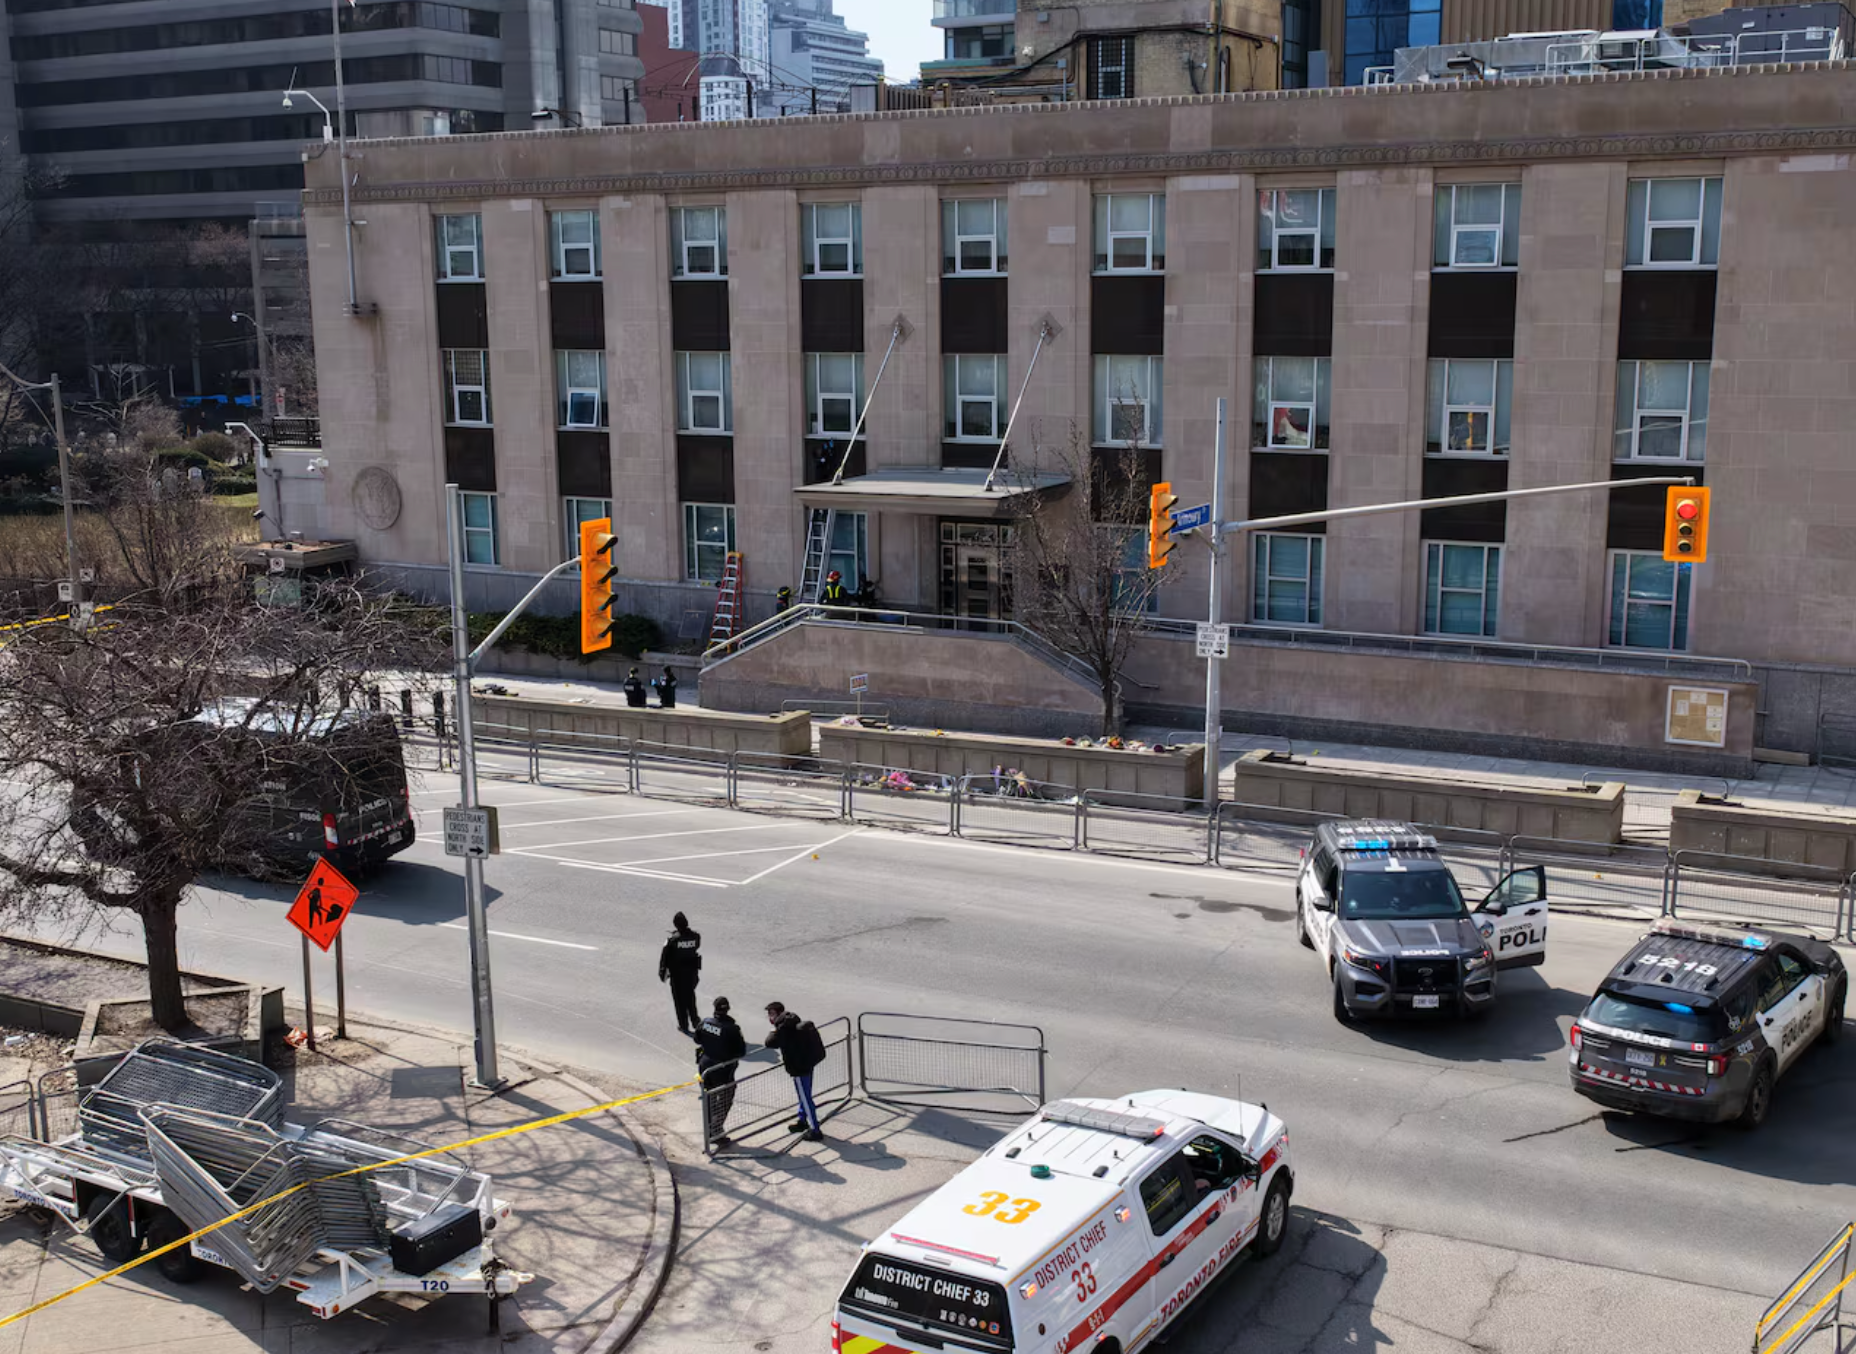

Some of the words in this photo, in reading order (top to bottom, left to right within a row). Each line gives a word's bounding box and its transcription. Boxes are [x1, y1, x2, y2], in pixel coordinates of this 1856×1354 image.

[446, 811, 485, 824] PEDESTRIANS
[450, 822, 469, 833] CROSS
[474, 825, 482, 833] AT
[448, 833, 466, 843] NORTH
[472, 835, 484, 845] SIDE
[448, 843, 464, 853] ONLY
[1499, 922, 1533, 934] TORONTO
[677, 940, 696, 948] POLICE
[1499, 926, 1547, 951] POLI
[1639, 953, 1718, 976] 5218
[702, 1021, 722, 1037] POLICE
[1610, 1027, 1672, 1048] POLICE
[961, 1189, 1042, 1225] 33
[1034, 1241, 1081, 1290] DISTRICT
[1080, 1220, 1107, 1254] CHIEF
[420, 1280, 449, 1291] T20
[873, 1263, 932, 1292] DISTRICT
[932, 1278, 971, 1303] CHIEF
[972, 1288, 990, 1307] 33
[1071, 1261, 1097, 1303] 33
[1160, 1258, 1217, 1323] TORONTO
[1217, 1230, 1243, 1269] FIRE
